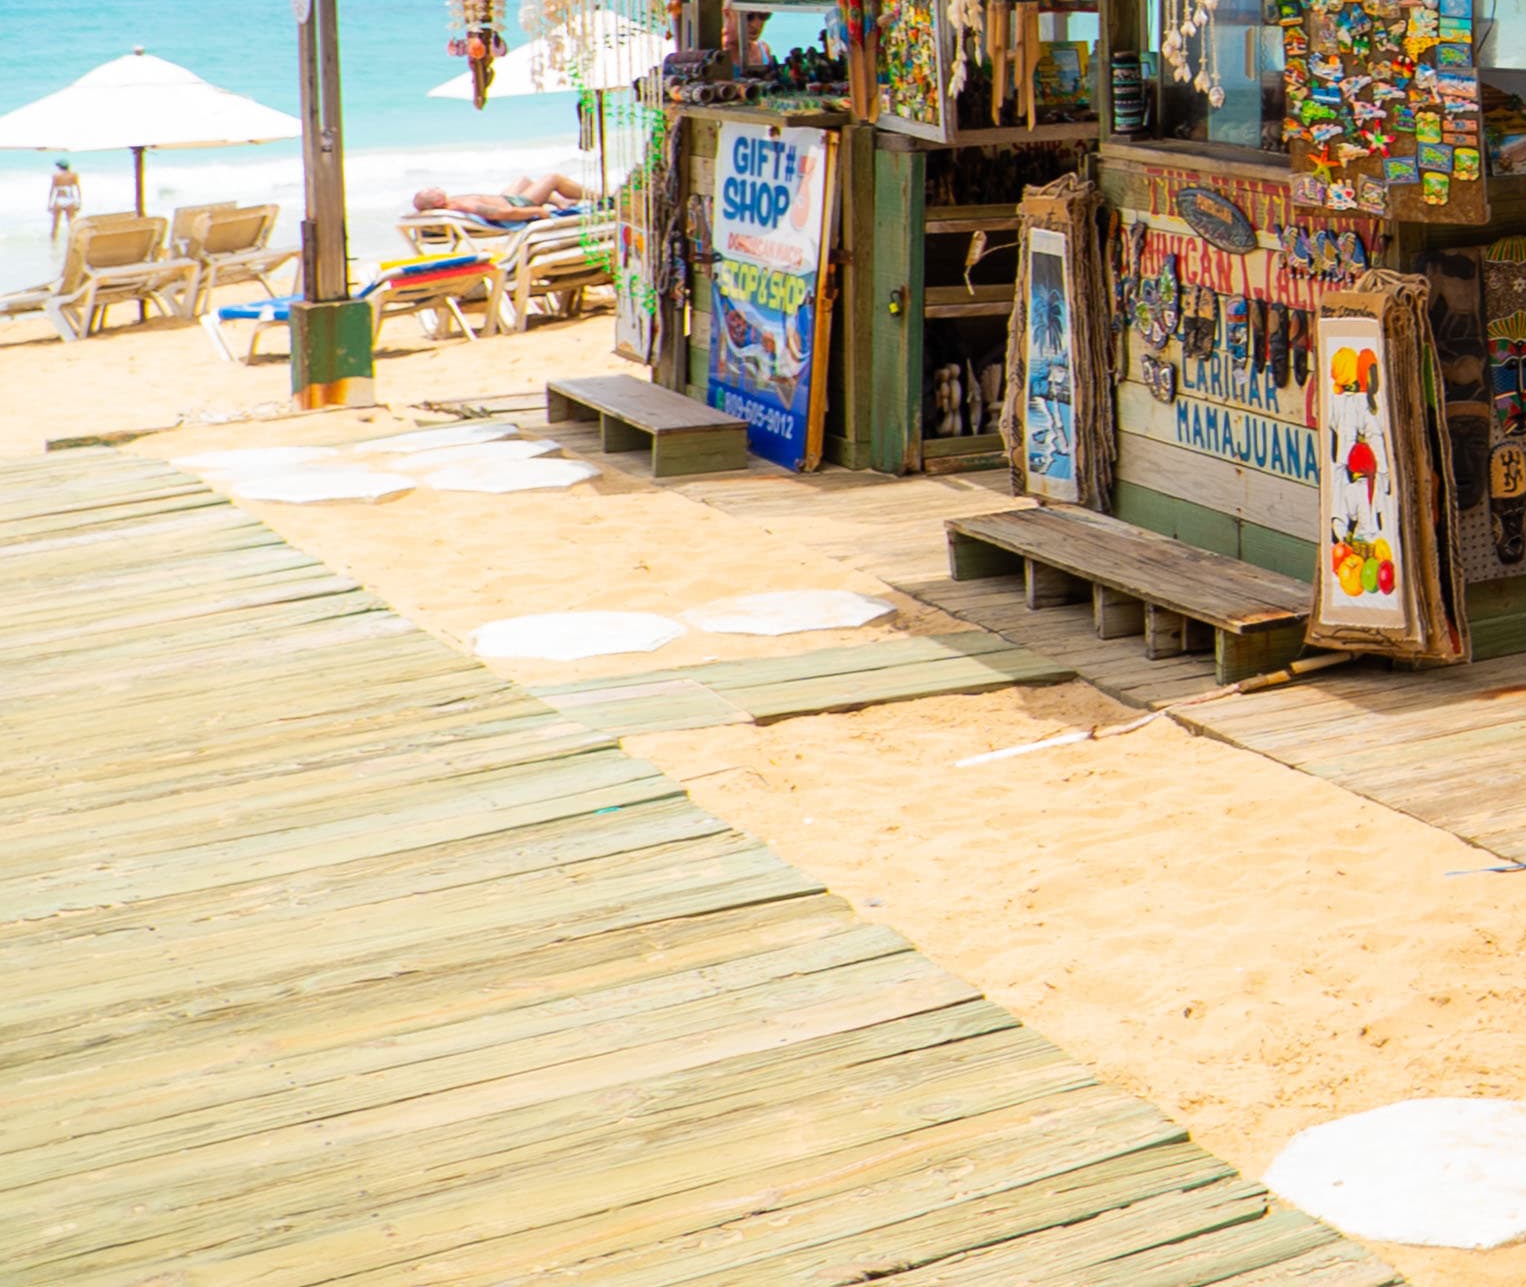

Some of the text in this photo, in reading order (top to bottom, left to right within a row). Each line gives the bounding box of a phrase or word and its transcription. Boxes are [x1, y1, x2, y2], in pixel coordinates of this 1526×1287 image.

[733, 136, 786, 181] GIFT
[722, 177, 791, 230] SHOP
[1146, 167, 1201, 217] TH
[768, 270, 806, 314] SHOP
[1176, 399, 1320, 484] MAMAJUANA
